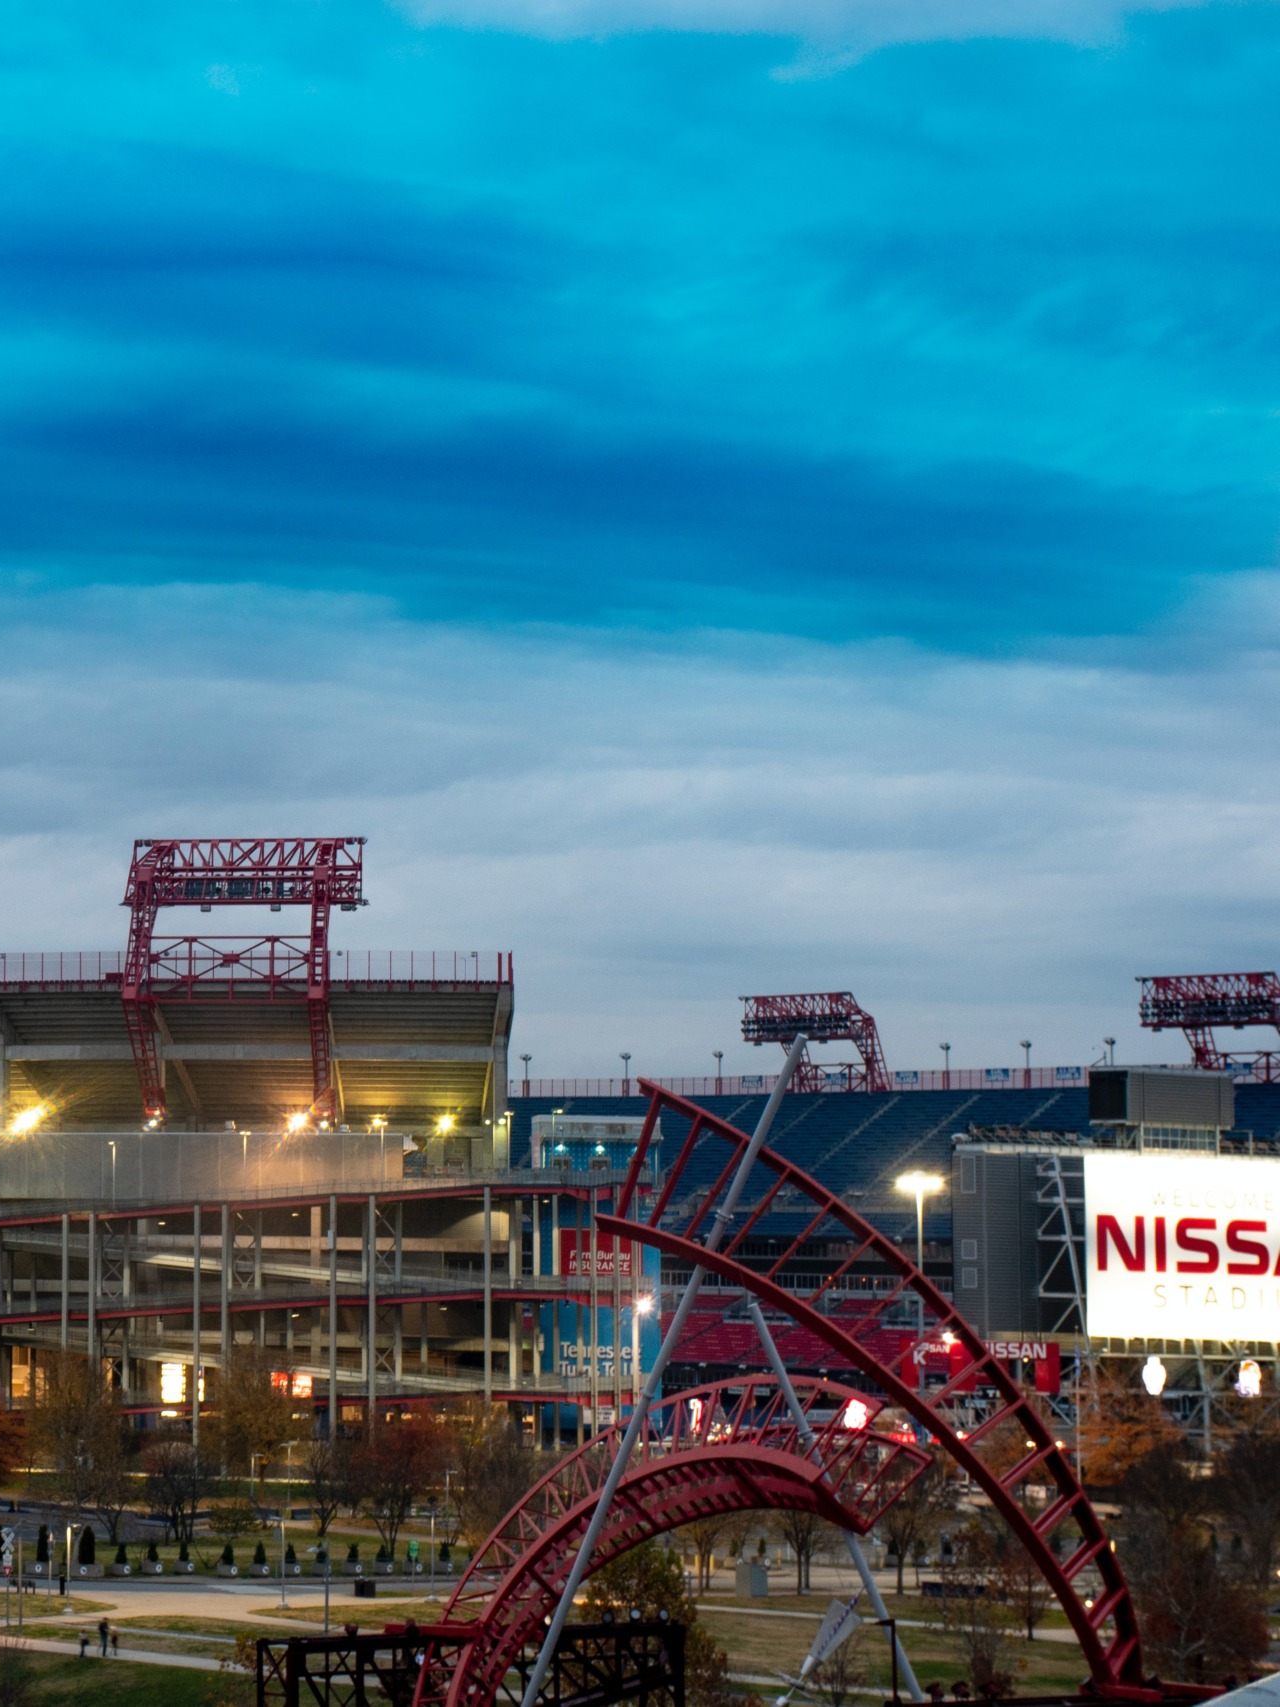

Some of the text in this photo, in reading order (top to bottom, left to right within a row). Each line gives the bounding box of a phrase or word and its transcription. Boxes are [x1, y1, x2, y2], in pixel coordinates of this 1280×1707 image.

[570, 1250, 631, 1261] Frm Burau
[1096, 1214, 1280, 1276] NISS
